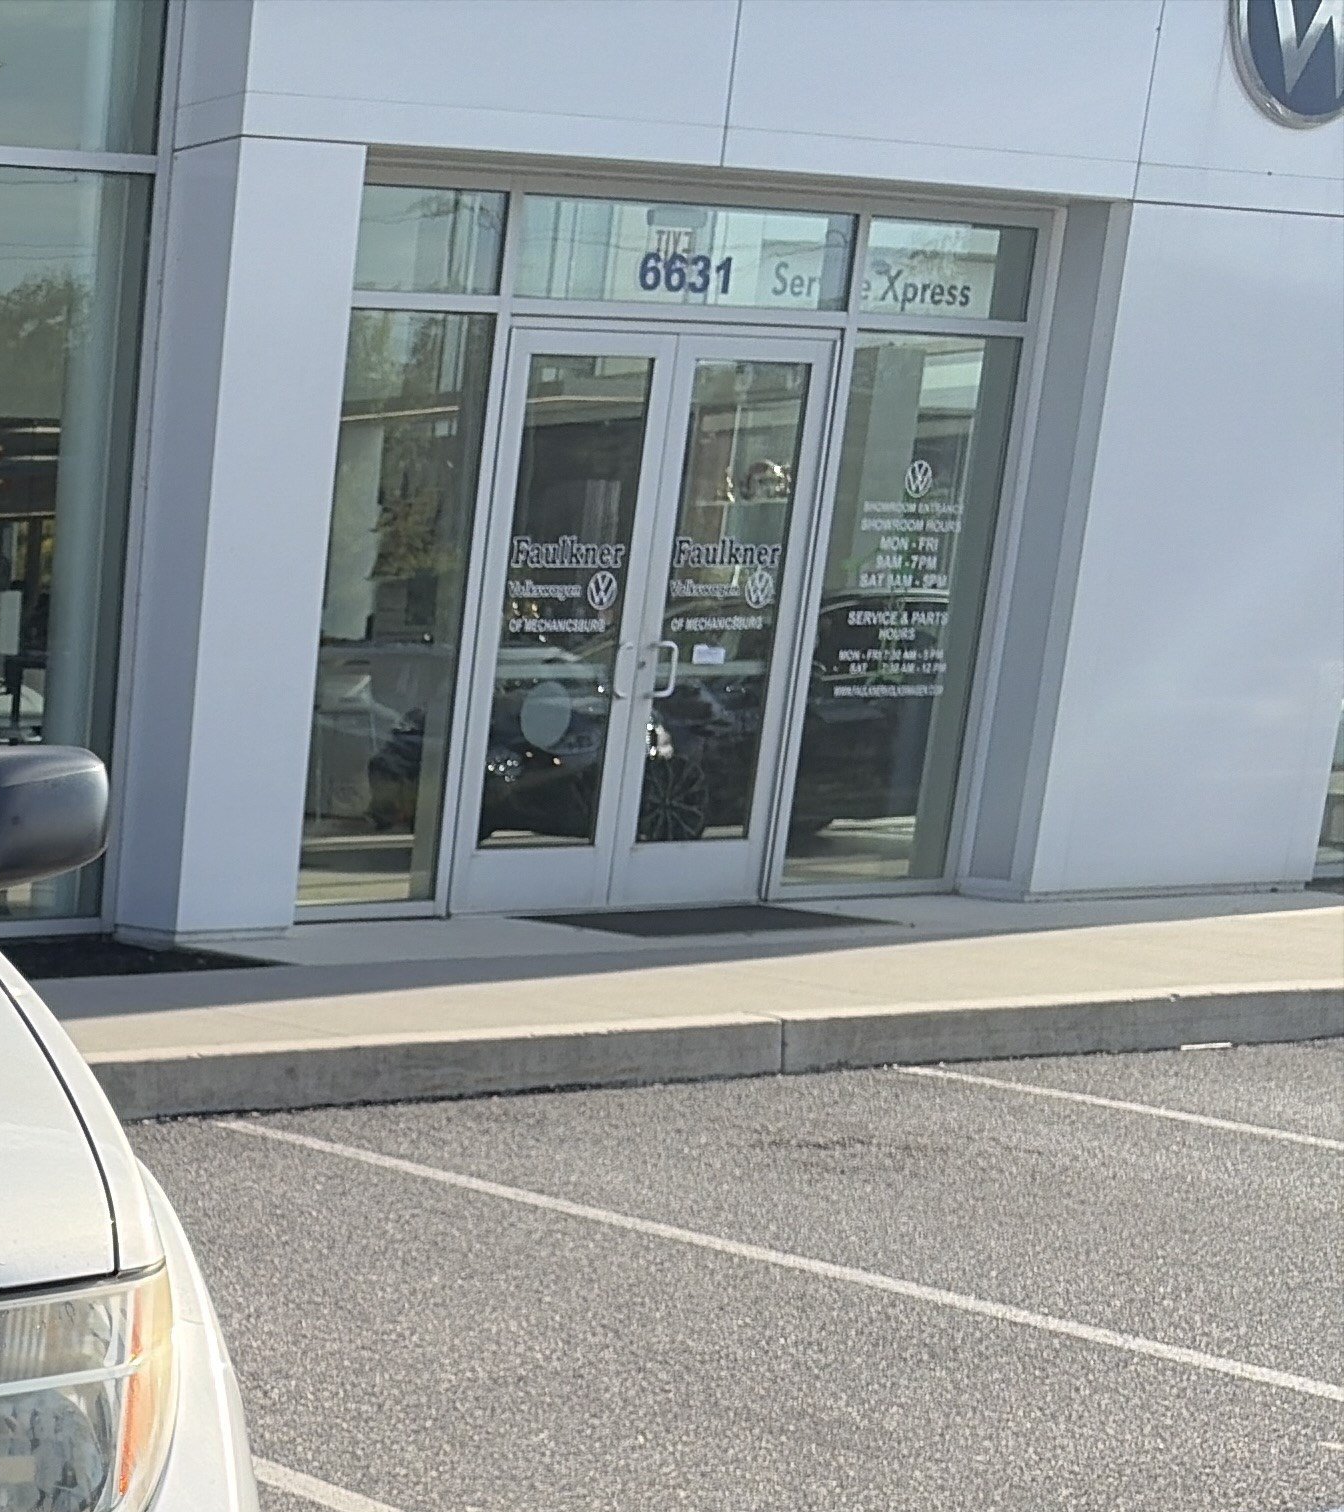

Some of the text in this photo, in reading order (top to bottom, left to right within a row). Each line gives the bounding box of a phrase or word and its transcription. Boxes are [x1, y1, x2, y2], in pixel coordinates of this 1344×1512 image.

[638, 252, 733, 295] 6631
[882, 268, 971, 311] Xpress
[861, 517, 924, 532] SHOWROOM
[879, 535, 909, 551] MON
[918, 536, 939, 551] FRI
[511, 535, 626, 568] Faulkner
[673, 536, 782, 568] Faulkner
[911, 555, 938, 570] 7PM
[859, 572, 885, 588] SAT
[524, 618, 606, 632] MECHANICSBURG
[686, 616, 763, 631] MECHANICSBURG
[847, 610, 949, 626] SERVICE & PARTS
[878, 627, 916, 641] HOURS
[849, 663, 868, 674] SAT
